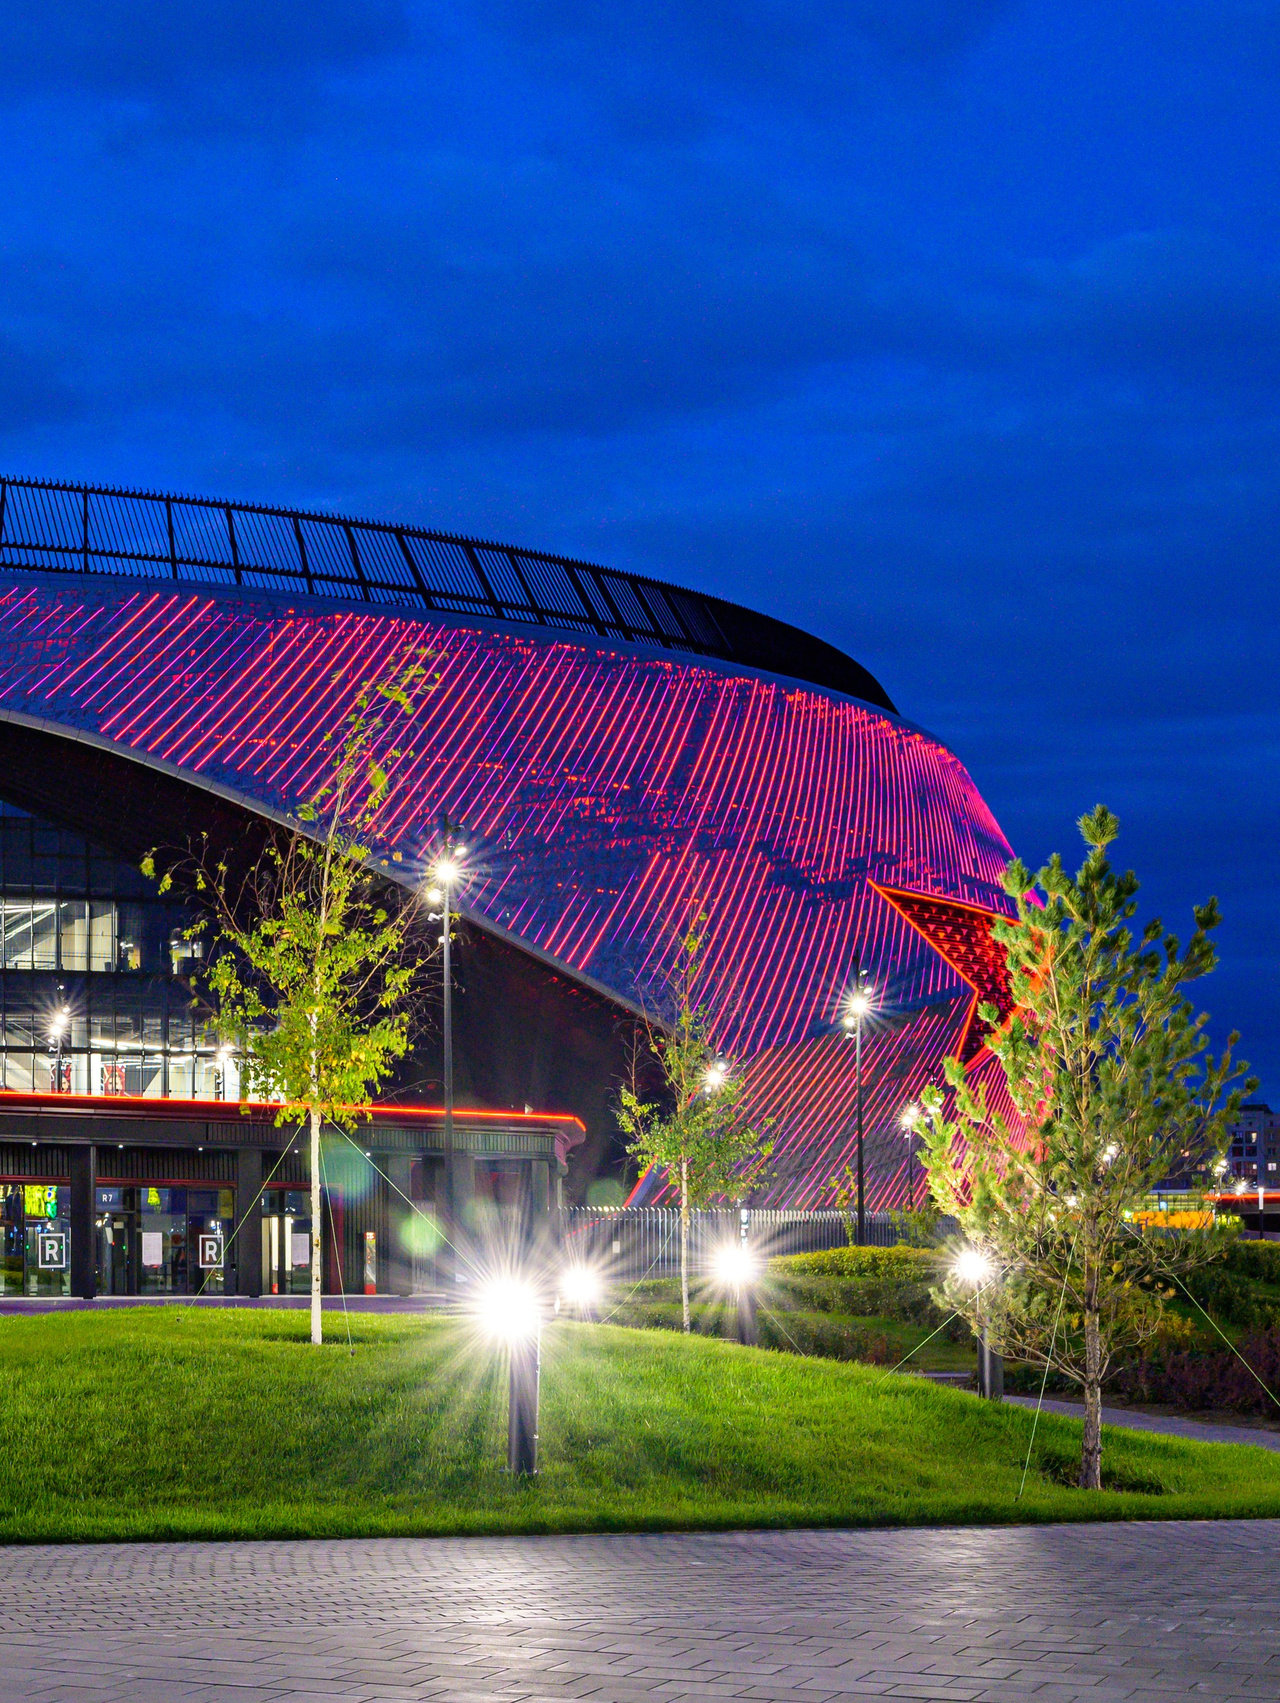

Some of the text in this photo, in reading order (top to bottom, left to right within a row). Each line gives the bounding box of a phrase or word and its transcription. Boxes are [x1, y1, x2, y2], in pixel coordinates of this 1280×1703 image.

[102, 1194, 113, 1202] R7
[45, 1239, 59, 1261] R
[205, 1240, 218, 1261] R
